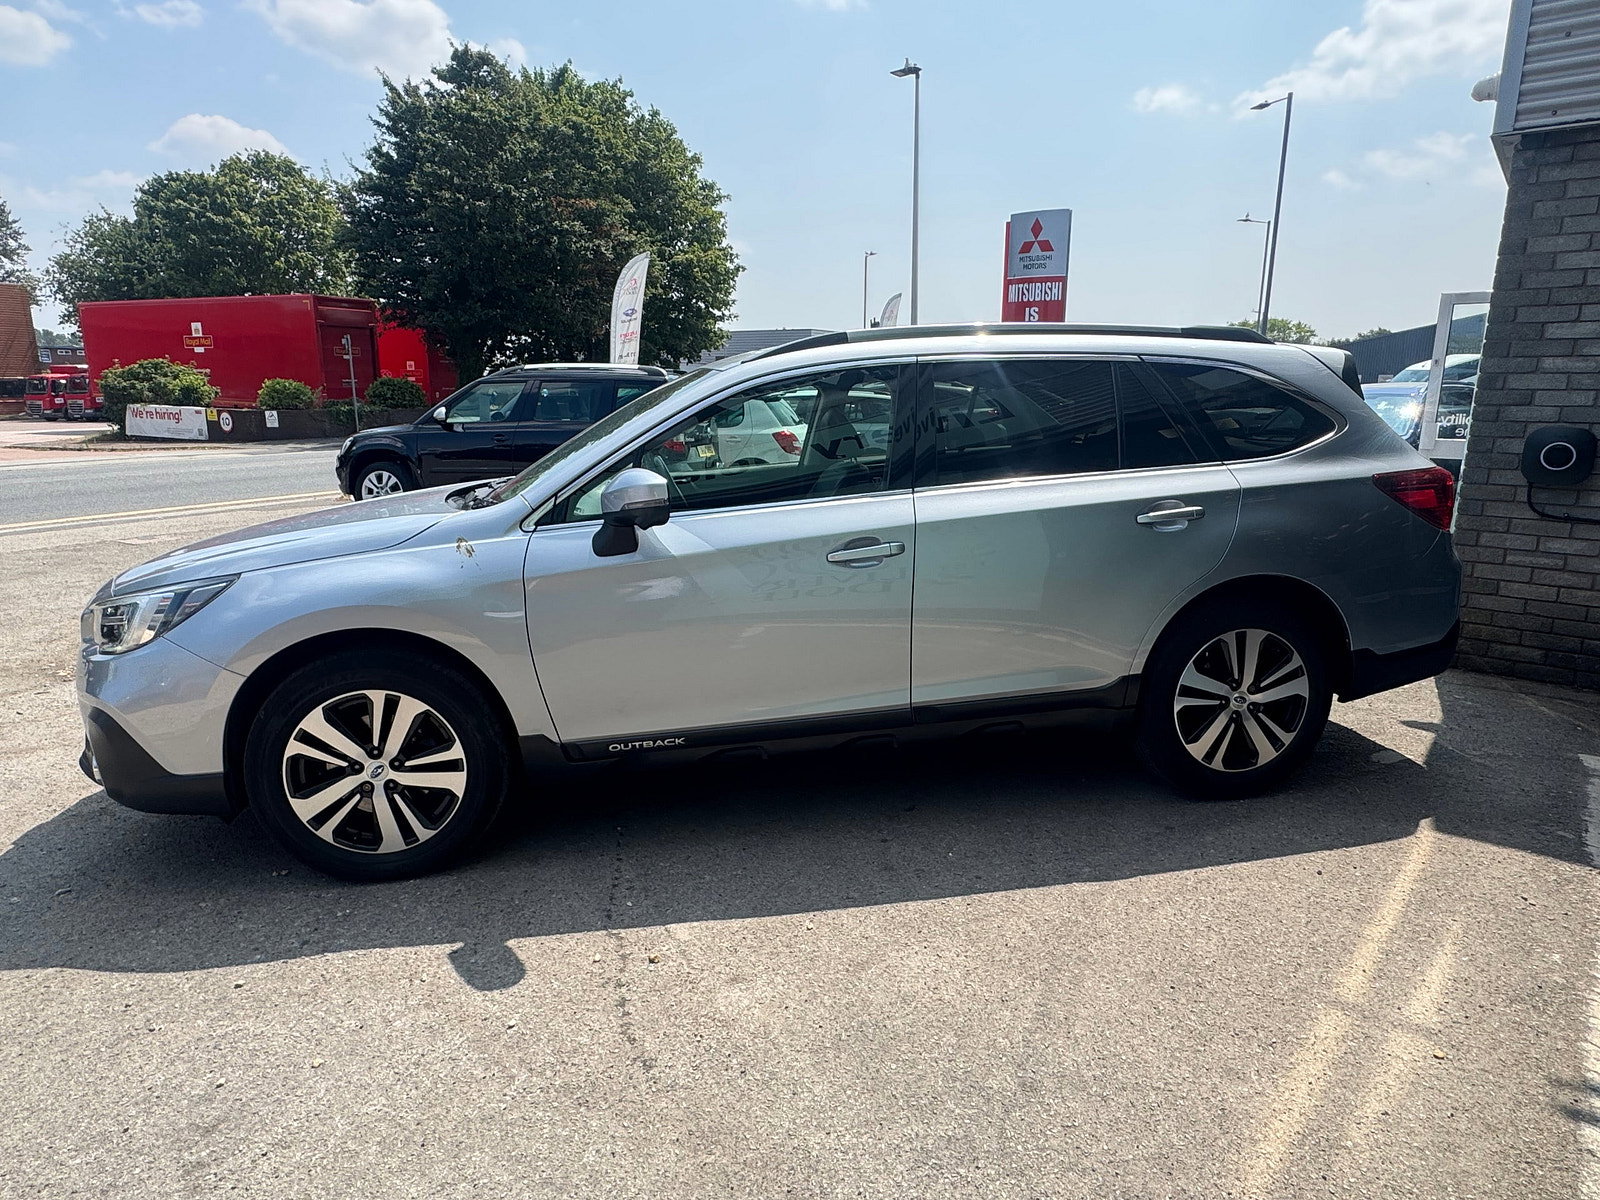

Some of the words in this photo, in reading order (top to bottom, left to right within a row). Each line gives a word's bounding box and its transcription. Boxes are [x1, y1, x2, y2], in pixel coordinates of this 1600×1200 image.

[1019, 254, 1052, 262] MITSUBISHI
[1008, 282, 1062, 302] MITSUBISHI
[1025, 307, 1039, 322] IS
[186, 337, 200, 347] Royal
[200, 337, 211, 345] Mail
[131, 407, 154, 419] We're
[155, 408, 182, 423] hiring!
[221, 417, 231, 426] 10
[609, 737, 686, 751] OUTBACK
